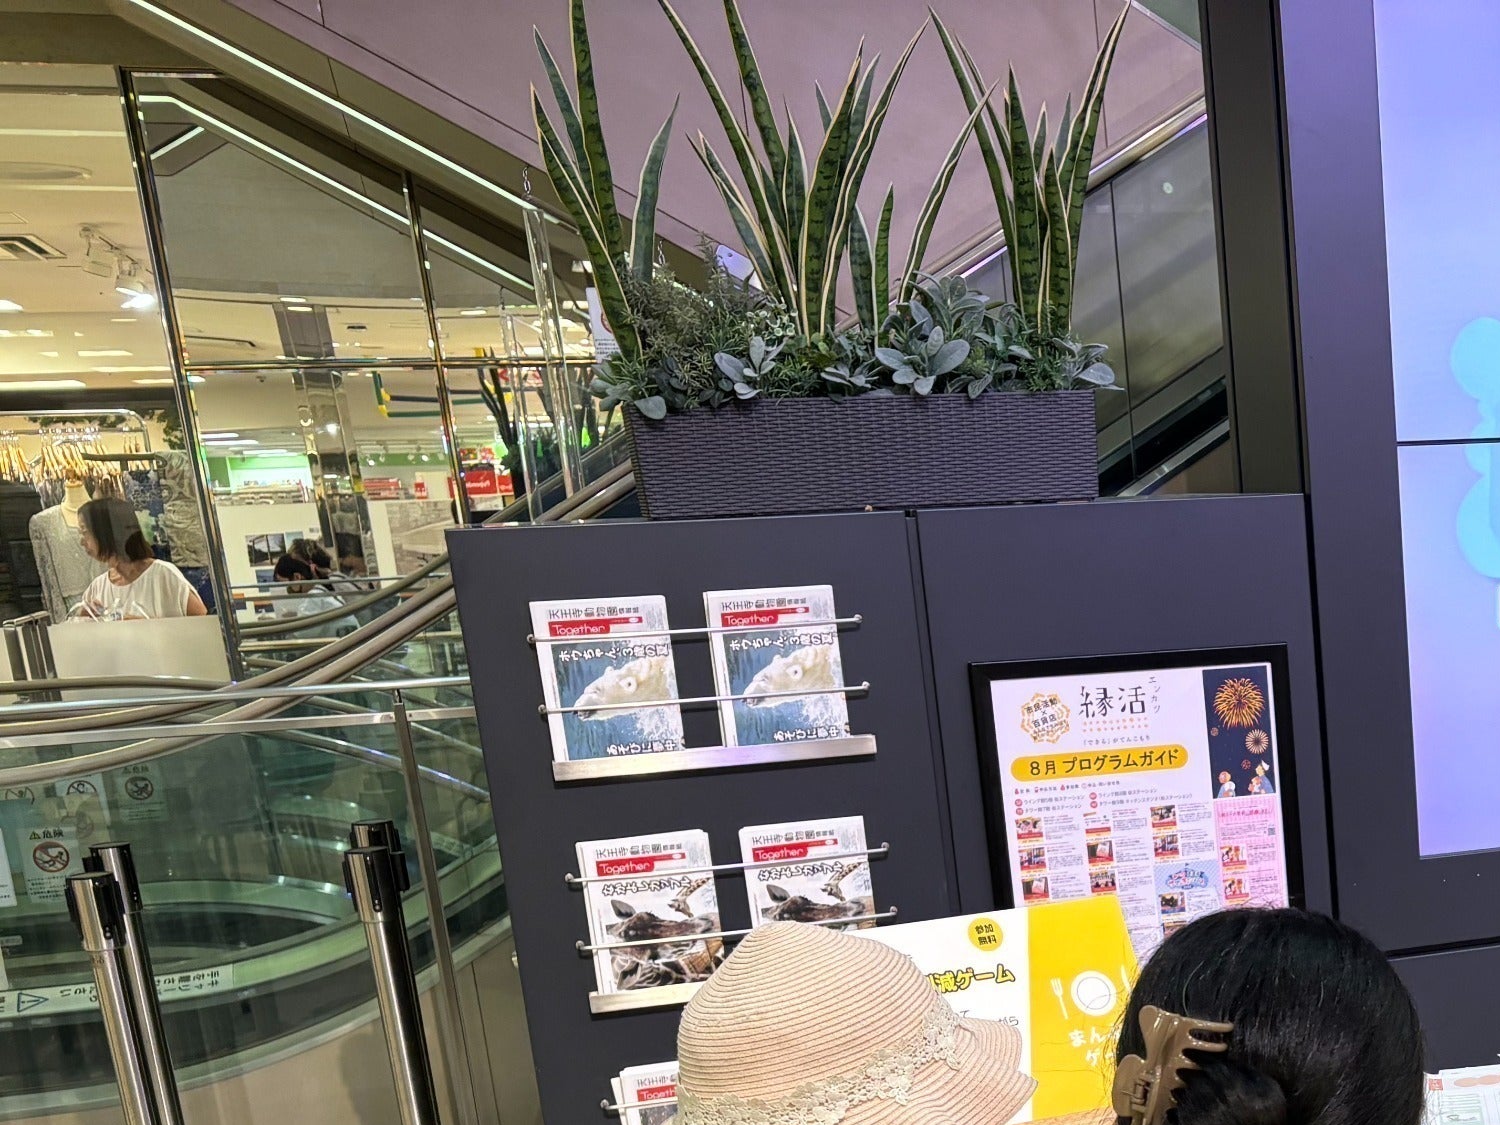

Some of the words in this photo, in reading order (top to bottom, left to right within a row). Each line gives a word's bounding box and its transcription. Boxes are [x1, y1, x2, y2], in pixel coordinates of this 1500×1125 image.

[724, 613, 775, 626] Together
[552, 623, 606, 636] Together
[1079, 686, 1146, 718] 縁活
[1030, 760, 1057, 776] 8月
[1063, 749, 1179, 773] プログラムガイド
[755, 846, 805, 861] Together
[599, 862, 652, 876] Together
